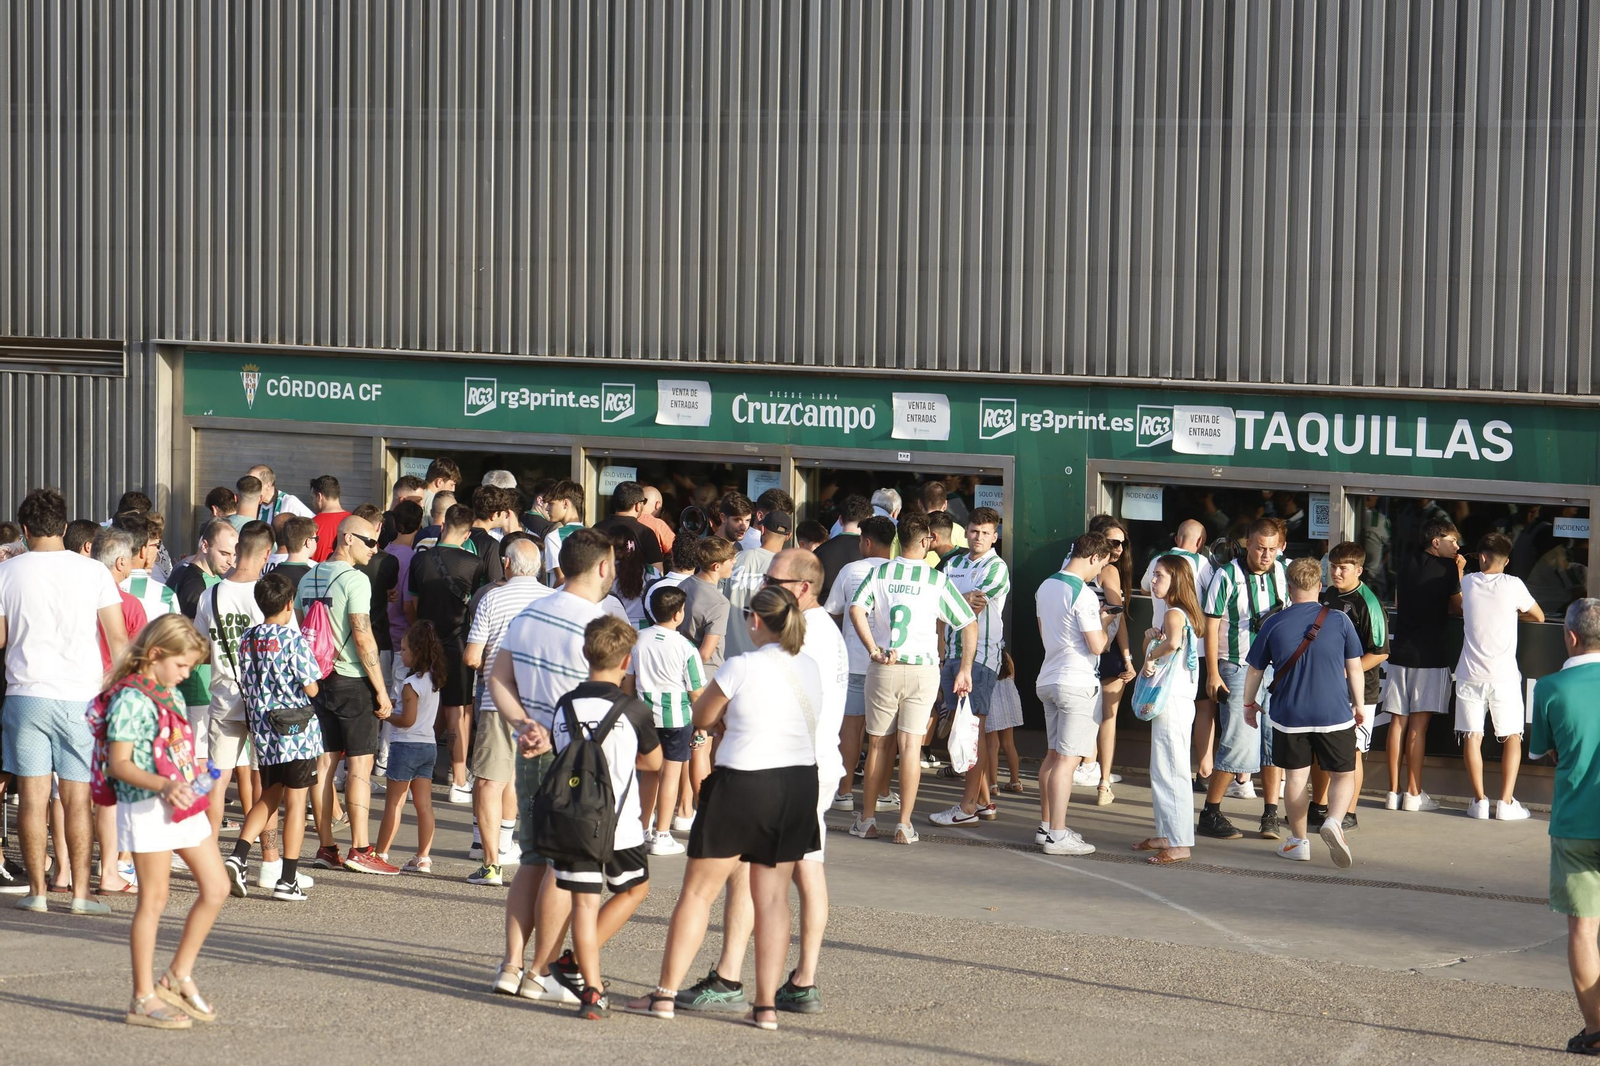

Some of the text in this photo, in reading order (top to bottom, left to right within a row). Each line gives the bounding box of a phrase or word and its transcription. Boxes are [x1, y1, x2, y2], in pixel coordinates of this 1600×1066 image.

[358, 383, 382, 401] CF
[467, 387, 493, 406] RG3
[500, 388, 600, 411] rg3print.es
[671, 387, 698, 397] VENTA DE
[769, 391, 802, 399] DESDE
[604, 393, 632, 412] RG3
[670, 399, 699, 410] ENTRADAS
[907, 401, 936, 411] VENTA DE
[731, 392, 876, 434] Cruzcampo
[906, 413, 937, 424] ENTRADAS
[982, 408, 1013, 428] RG3
[1020, 410, 1134, 433] rg3print.es
[1190, 414, 1221, 425] VENTA DE
[1139, 415, 1171, 436] RG3
[1188, 427, 1222, 438] ENTRADAS
[1235, 409, 1514, 462] TAQUILLAS
[1555, 524, 1590, 532] INCIDENCIA
[888, 583, 921, 596] GUDELJ
[889, 604, 912, 649] 8
